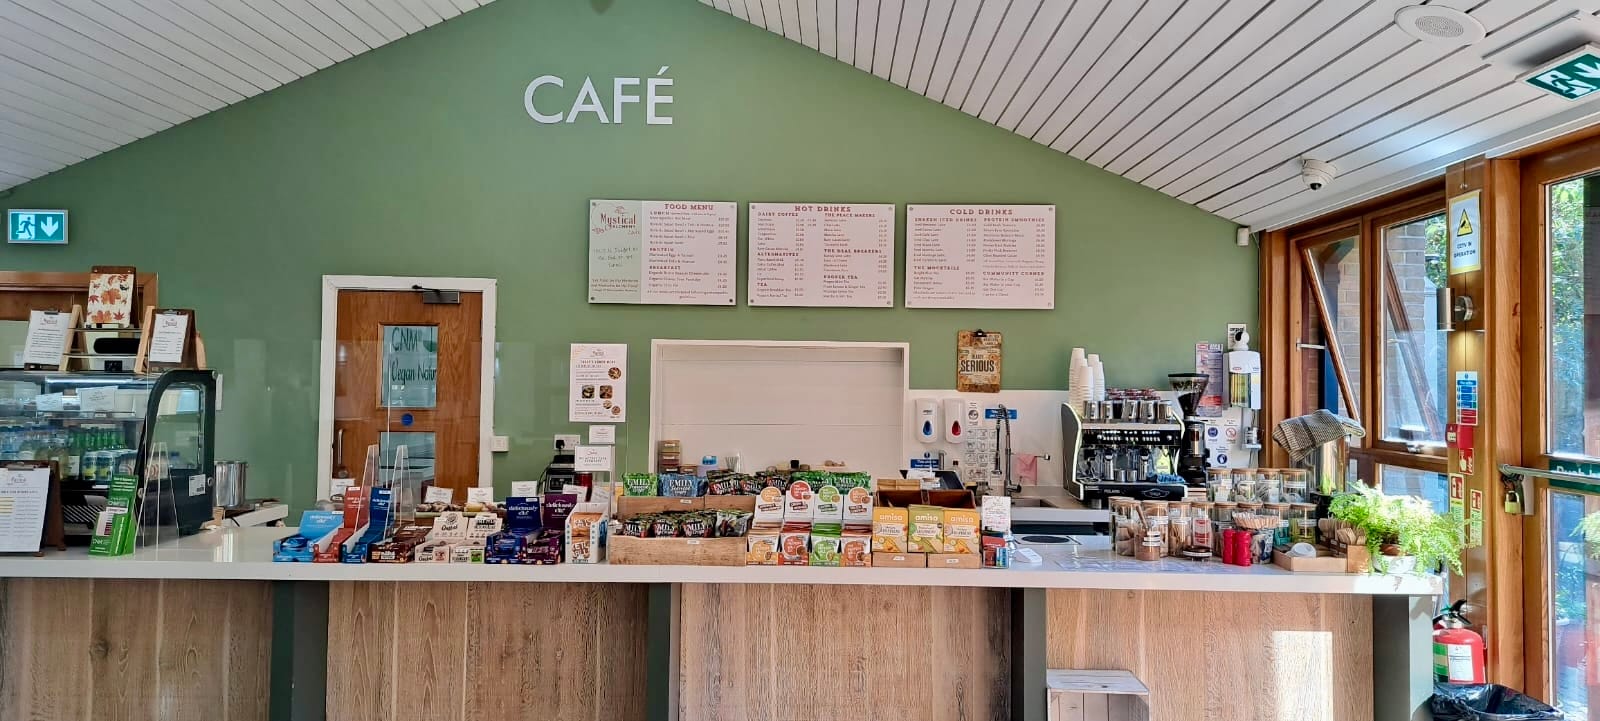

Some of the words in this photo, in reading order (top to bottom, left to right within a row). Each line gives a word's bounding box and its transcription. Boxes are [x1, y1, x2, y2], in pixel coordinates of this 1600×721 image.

[524, 66, 674, 125] CAFÉ
[600, 213, 636, 228] Mystical
[1453, 249, 1476, 258] OPERATION
[392, 327, 418, 352] CNM
[960, 359, 995, 373] SERIOUS
[669, 479, 693, 488] EMILY
[508, 504, 538, 513] deliciously
[879, 512, 903, 521] amisa
[915, 513, 939, 522] amisa
[950, 514, 975, 523] amisa
